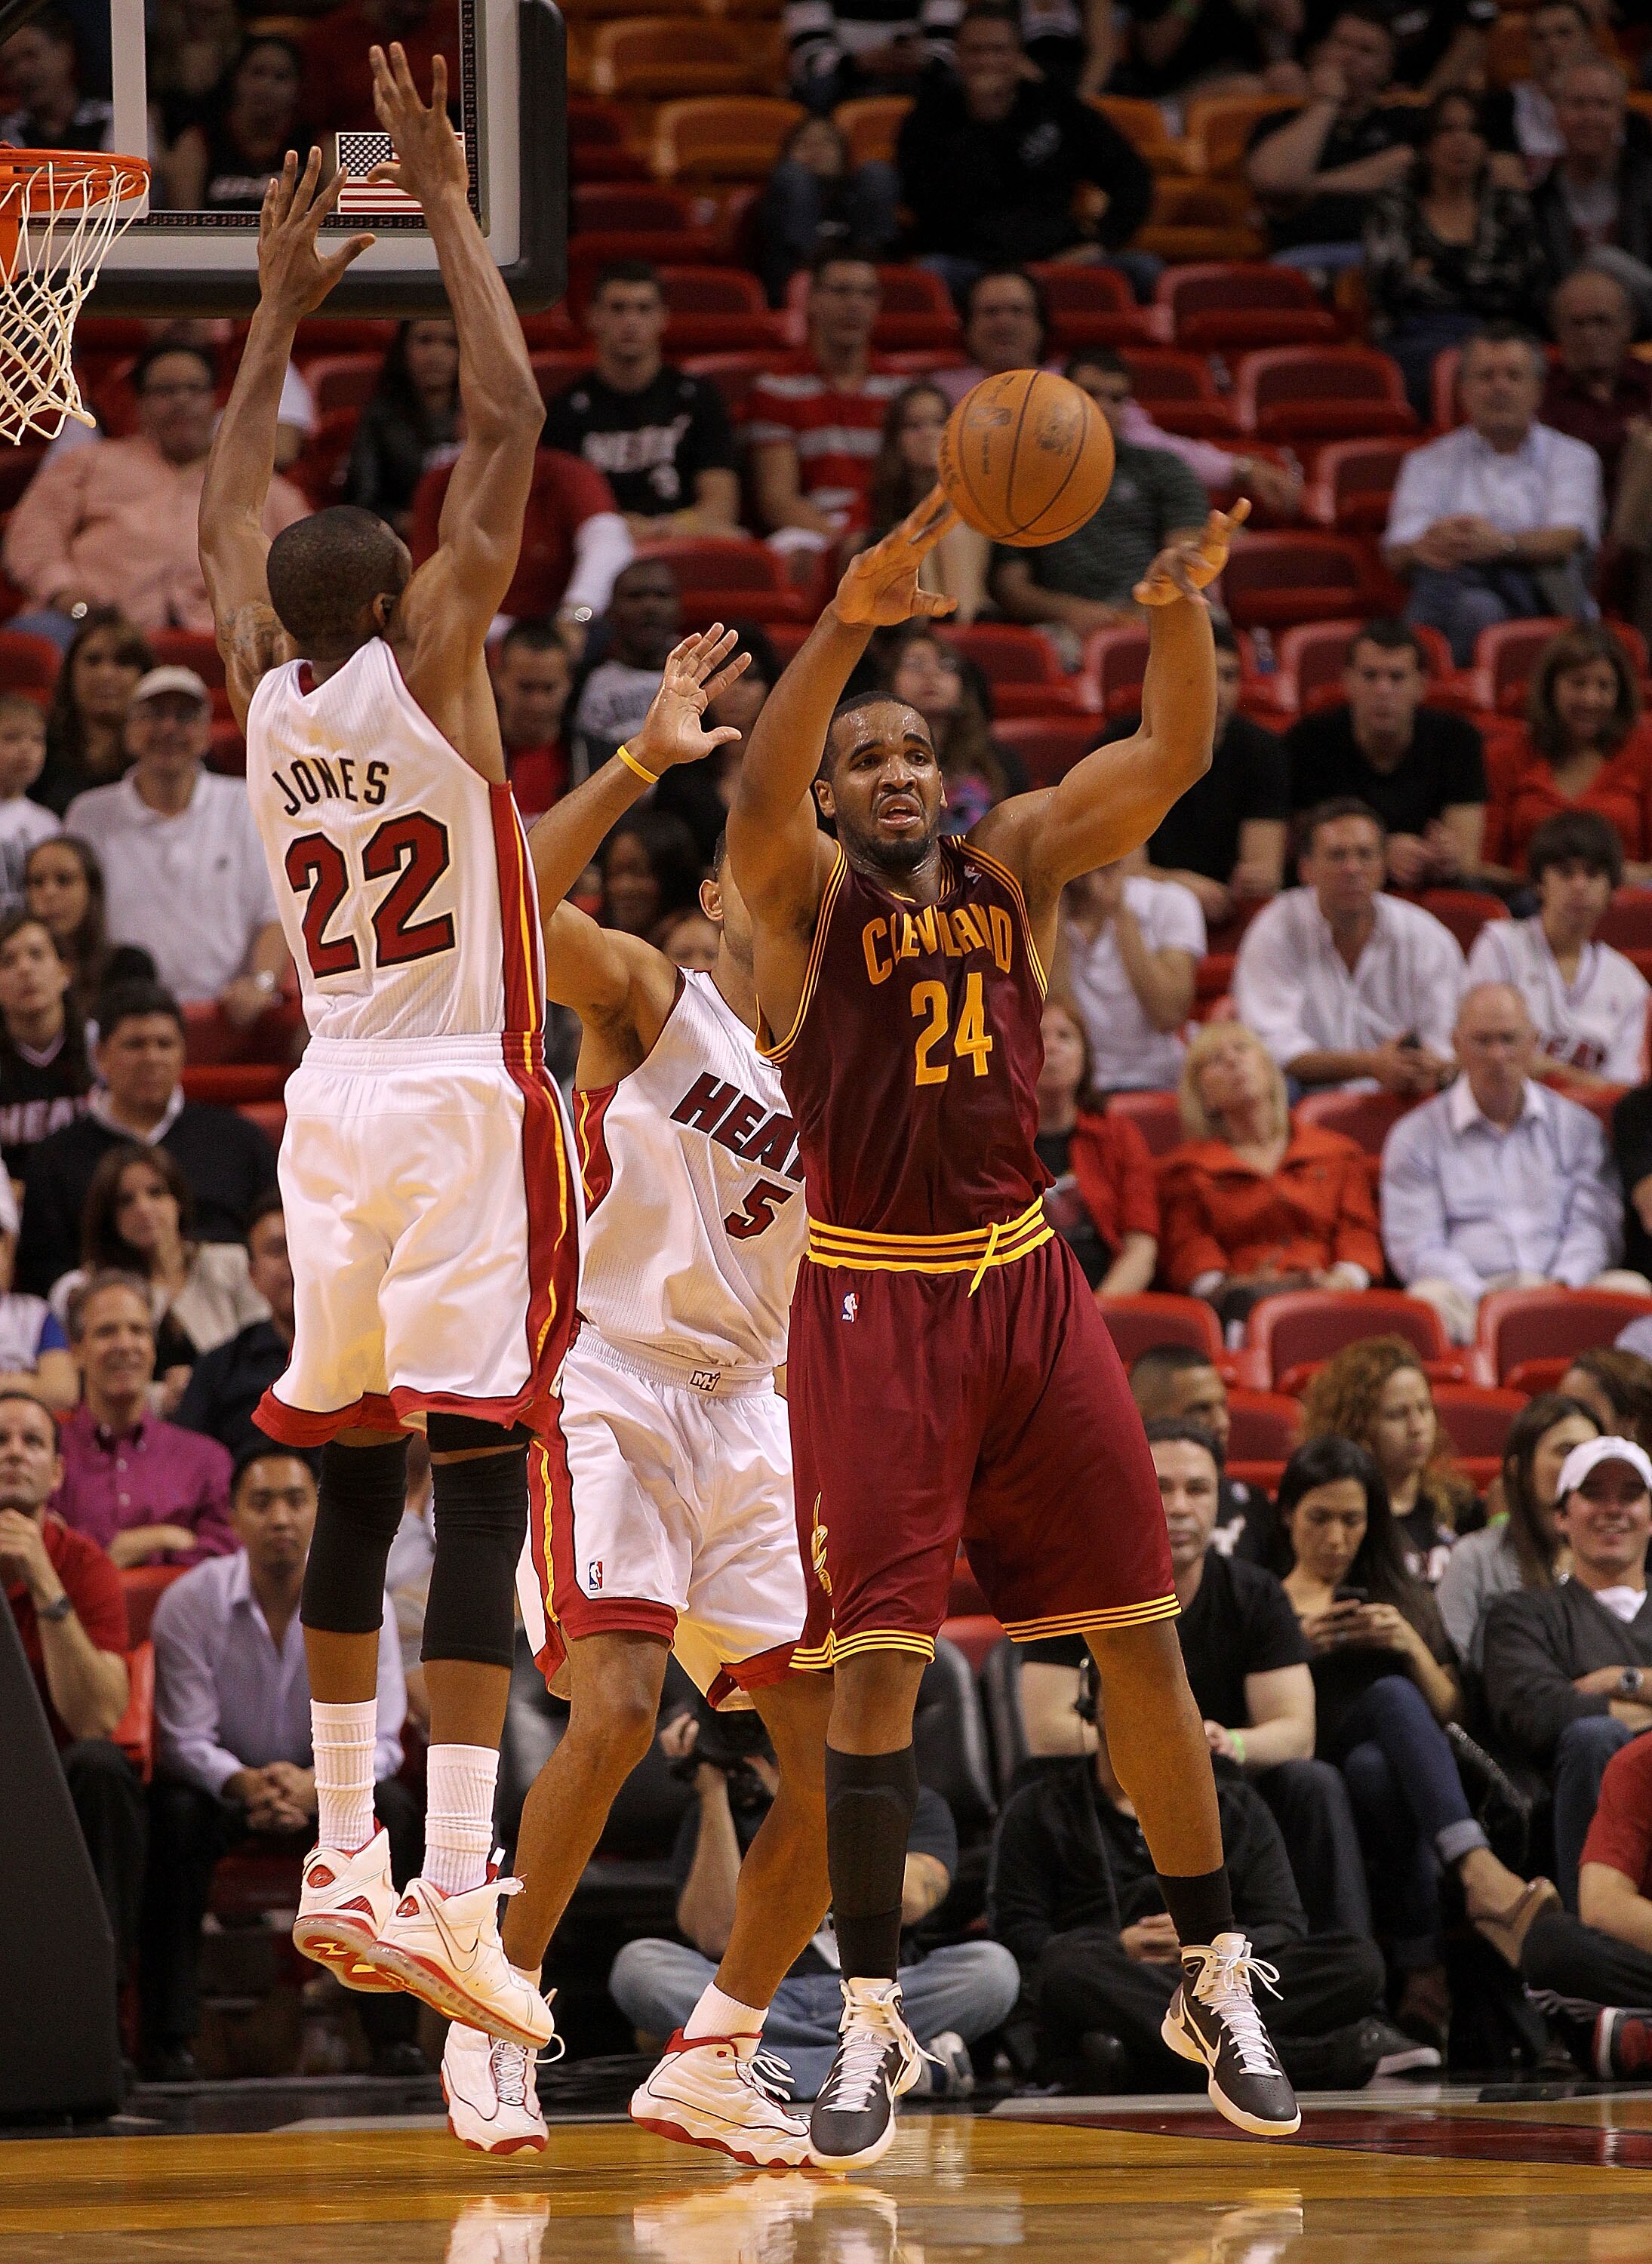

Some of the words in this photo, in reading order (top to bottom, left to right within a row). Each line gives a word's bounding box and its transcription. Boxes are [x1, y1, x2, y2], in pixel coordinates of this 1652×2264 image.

[272, 758, 389, 817] JONES
[285, 810, 457, 980] 22
[862, 903, 1013, 986] CLEVLAND
[910, 972, 993, 1087] 24
[723, 1177, 795, 1241] 5
